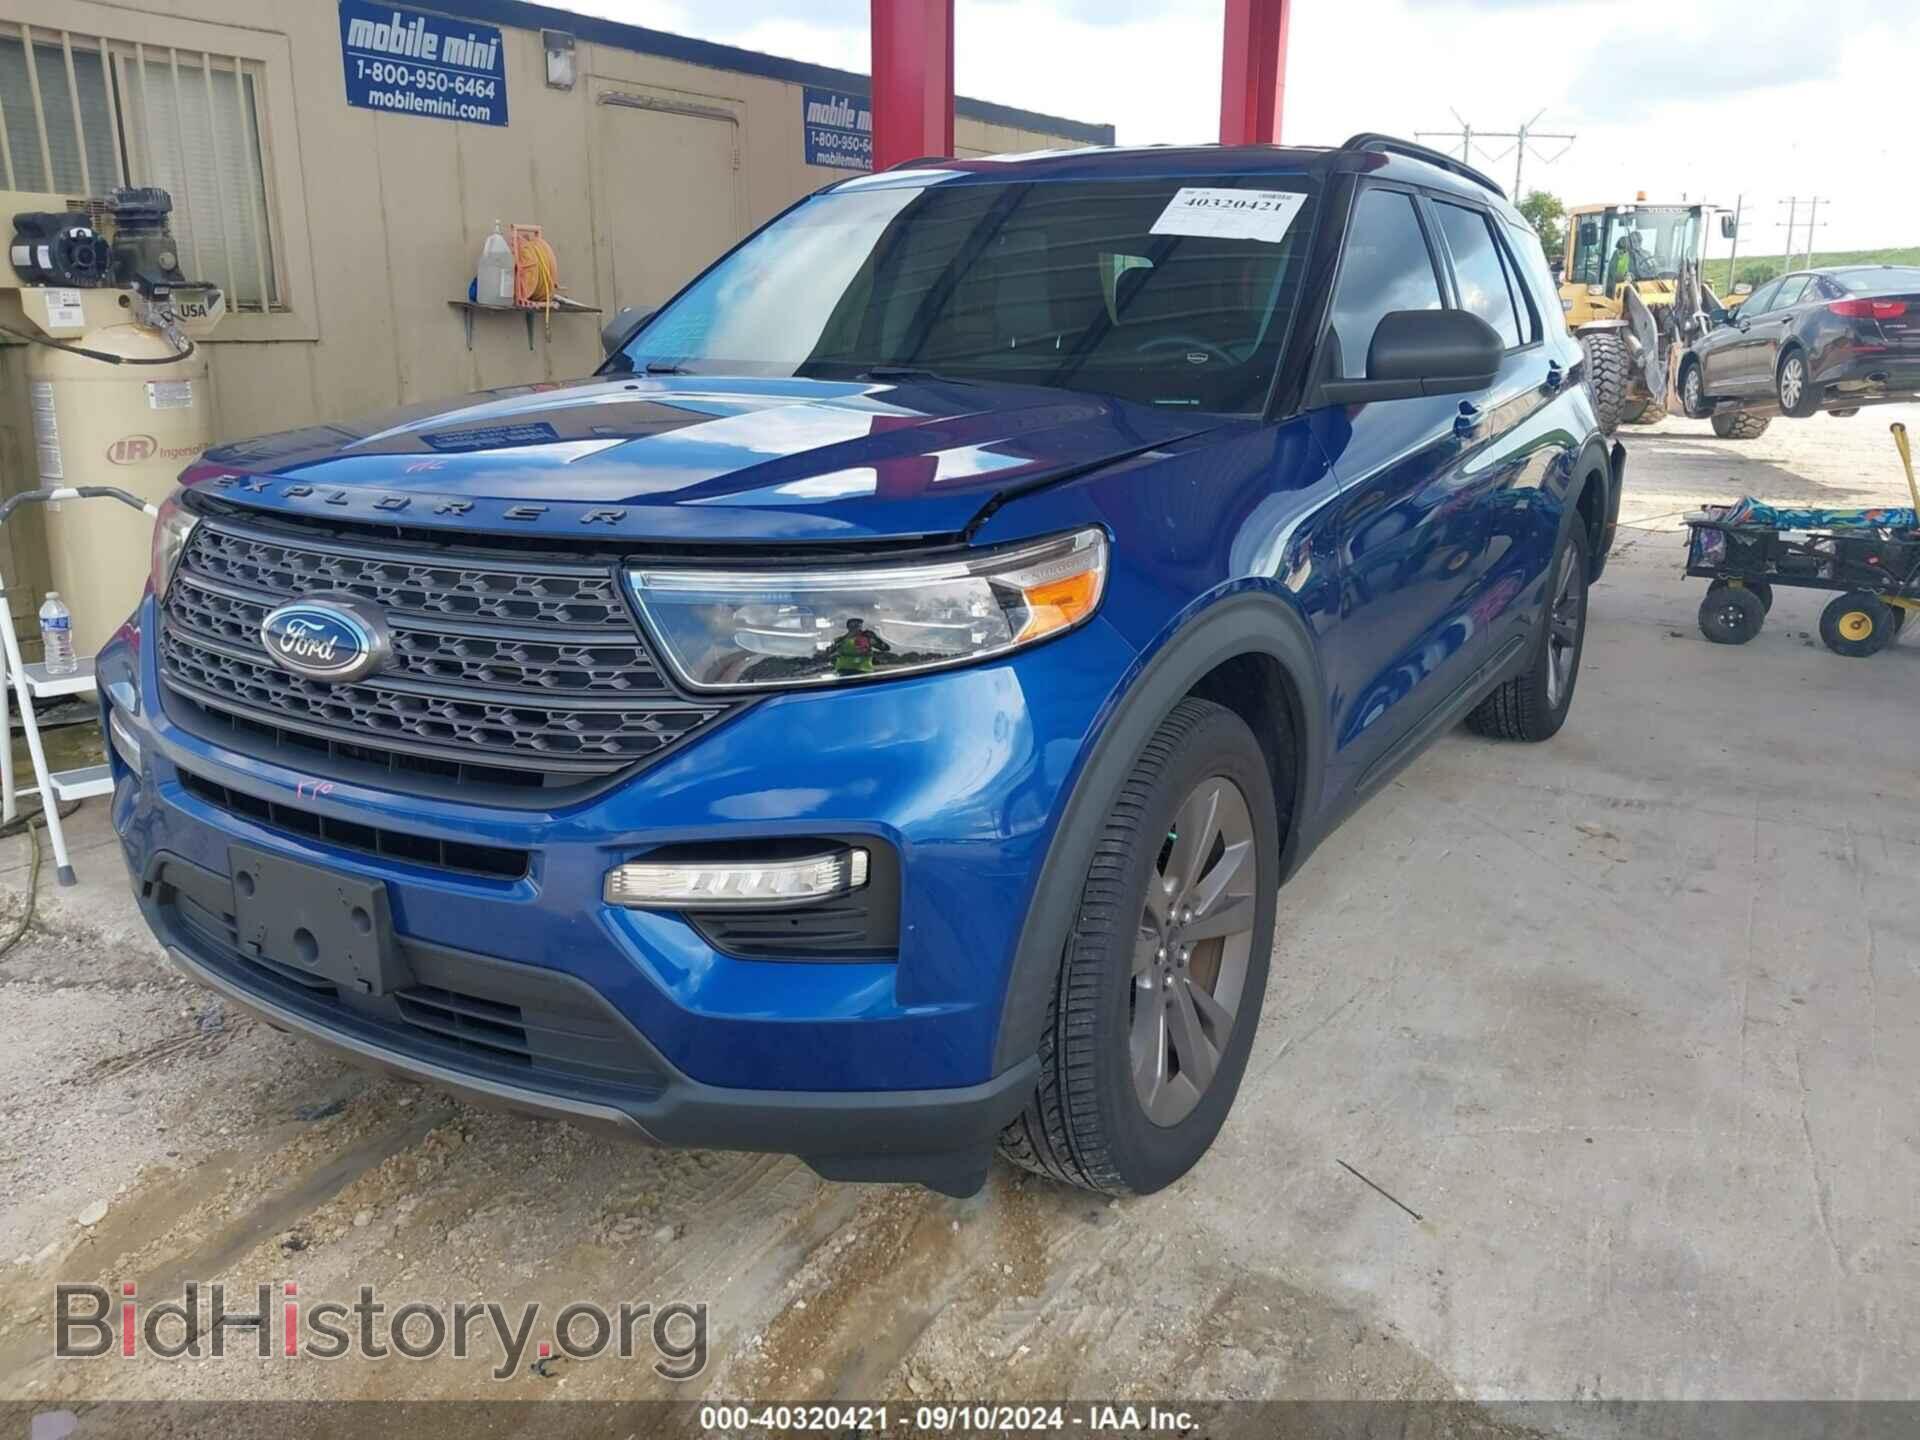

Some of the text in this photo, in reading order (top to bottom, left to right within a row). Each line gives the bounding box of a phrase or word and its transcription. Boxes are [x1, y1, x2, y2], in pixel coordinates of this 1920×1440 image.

[347, 12, 498, 71] mobile mini
[356, 59, 496, 99] 1-800-950-6464
[368, 90, 491, 121] mobilemini.com
[806, 95, 856, 129] mobile
[1184, 198, 1283, 212] 40320421
[180, 303, 208, 318] USA
[213, 474, 627, 526] EXPLORER
[279, 618, 339, 661] Ford
